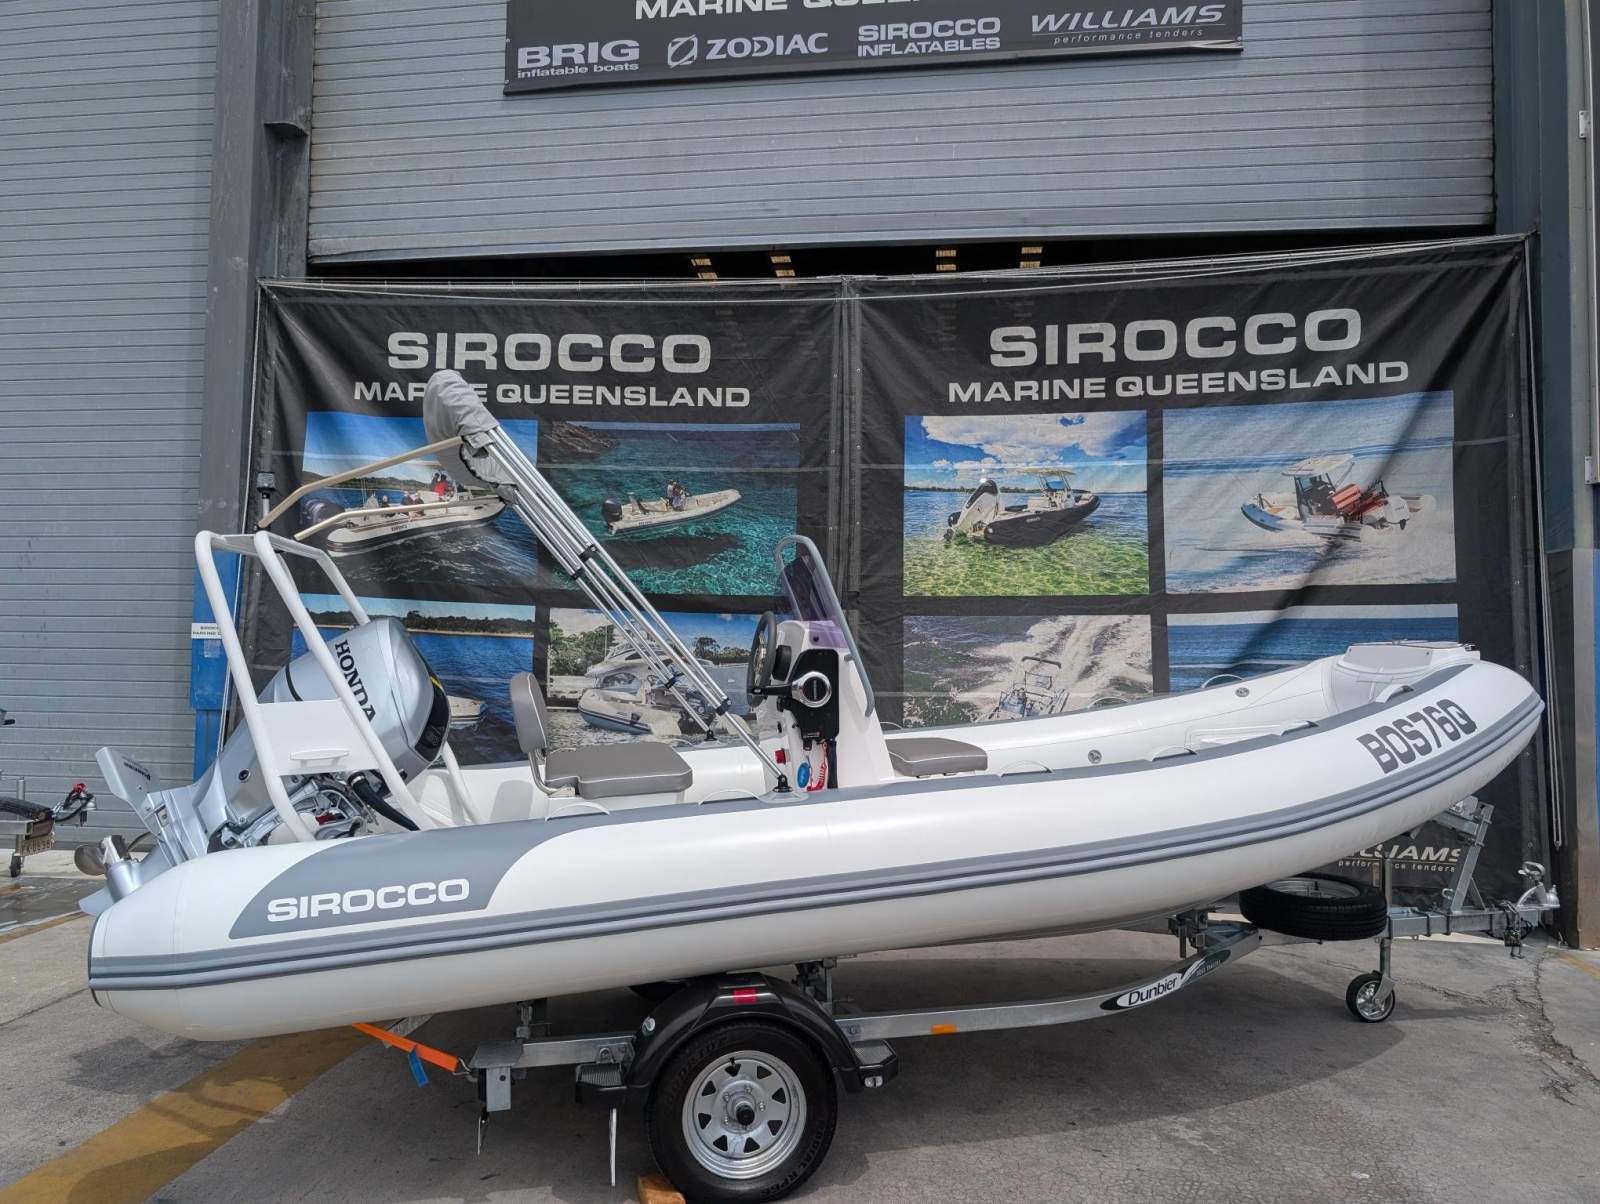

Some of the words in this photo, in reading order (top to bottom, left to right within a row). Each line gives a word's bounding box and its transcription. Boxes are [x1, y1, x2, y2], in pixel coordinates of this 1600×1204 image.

[635, 0, 788, 20] MARINE
[1031, 4, 1226, 33] WILLIAMS
[858, 17, 1001, 42] SIROCCO
[1054, 32, 1141, 46] performance
[1149, 29, 1204, 39] tenders
[517, 40, 640, 69] BRIG
[706, 33, 829, 60] ZODIAC
[857, 37, 1001, 57] INFLATABLES
[517, 65, 588, 79] inflatable
[593, 62, 639, 73] boats
[990, 308, 1362, 367] SIROCCO
[387, 331, 712, 374] SIROCCO
[354, 381, 488, 402] MARE
[496, 384, 750, 407] QUEENSLAND
[949, 377, 1106, 403] MARINE
[1115, 360, 1409, 398] QUEENSLAND
[334, 639, 377, 723] HONDA
[1338, 860, 1407, 870] perforce
[1412, 863, 1456, 873] tenders
[267, 878, 470, 922] SIROCCO
[1128, 977, 1178, 1006] Dunbier
